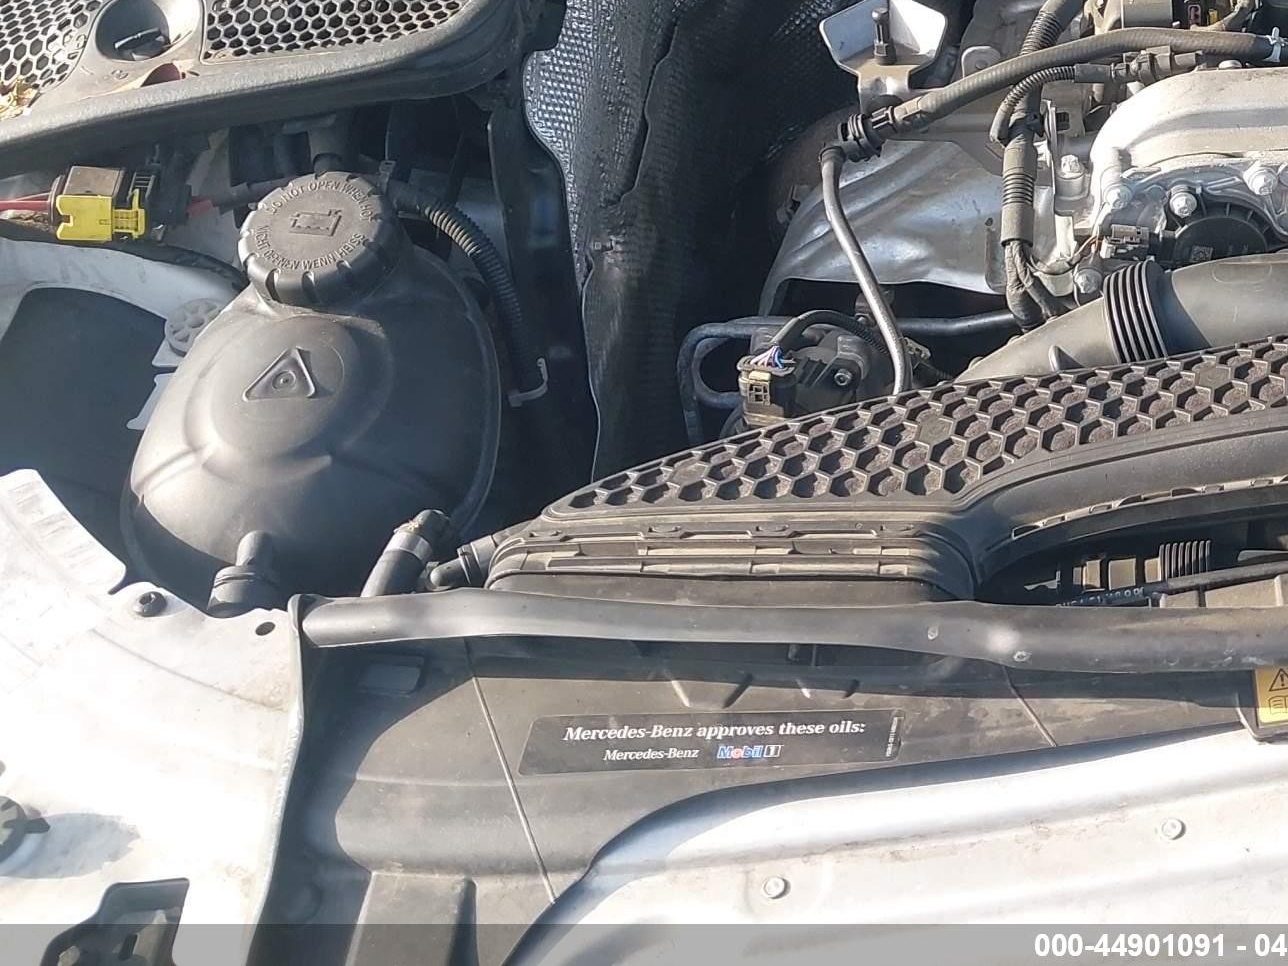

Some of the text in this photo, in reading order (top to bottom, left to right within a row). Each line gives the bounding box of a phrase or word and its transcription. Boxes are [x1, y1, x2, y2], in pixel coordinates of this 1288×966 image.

[281, 185, 305, 203] NOT
[308, 180, 341, 192] OPEN
[341, 182, 369, 205] WHEN
[302, 253, 338, 271] WENN
[563, 720, 866, 741] Mercedes-Benz approves these oils:
[602, 747, 700, 761] Mercedes-Benz
[717, 745, 763, 759] Mobil
